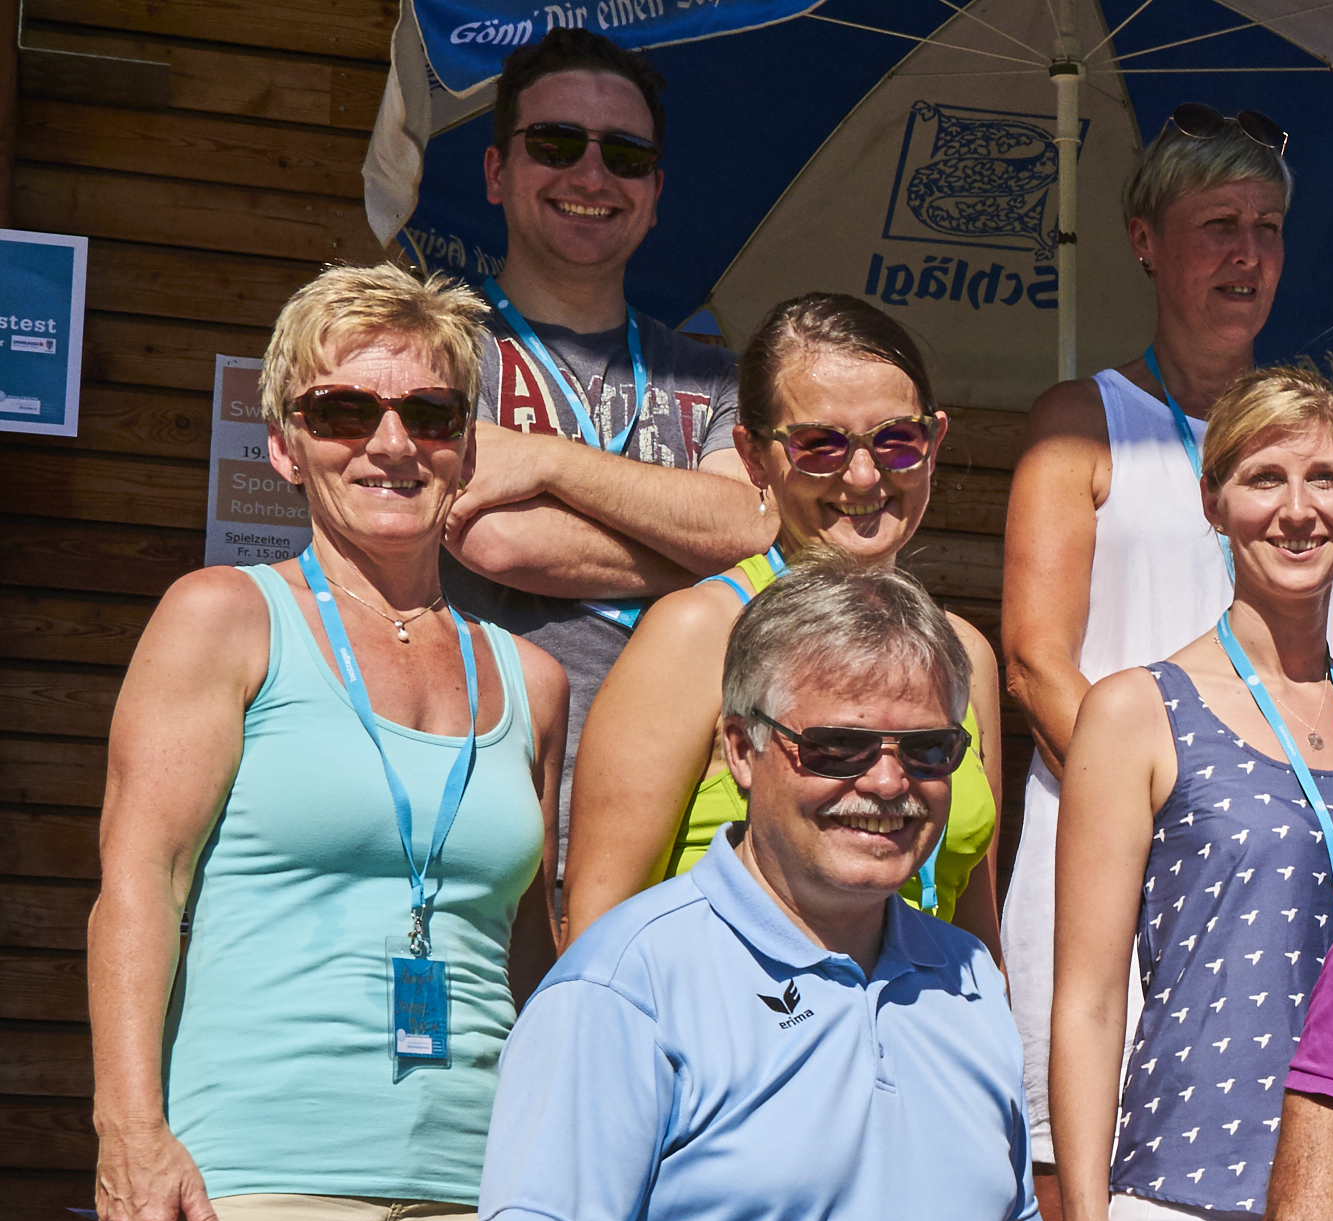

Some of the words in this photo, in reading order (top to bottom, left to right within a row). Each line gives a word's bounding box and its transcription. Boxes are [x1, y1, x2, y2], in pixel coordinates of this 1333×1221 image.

[232, 473, 294, 493] Sport
[225, 532, 291, 547] Spielzeiten
[237, 547, 251, 558] Fr.
[256, 549, 289, 560] 15:00
[779, 1009, 815, 1030] erima
